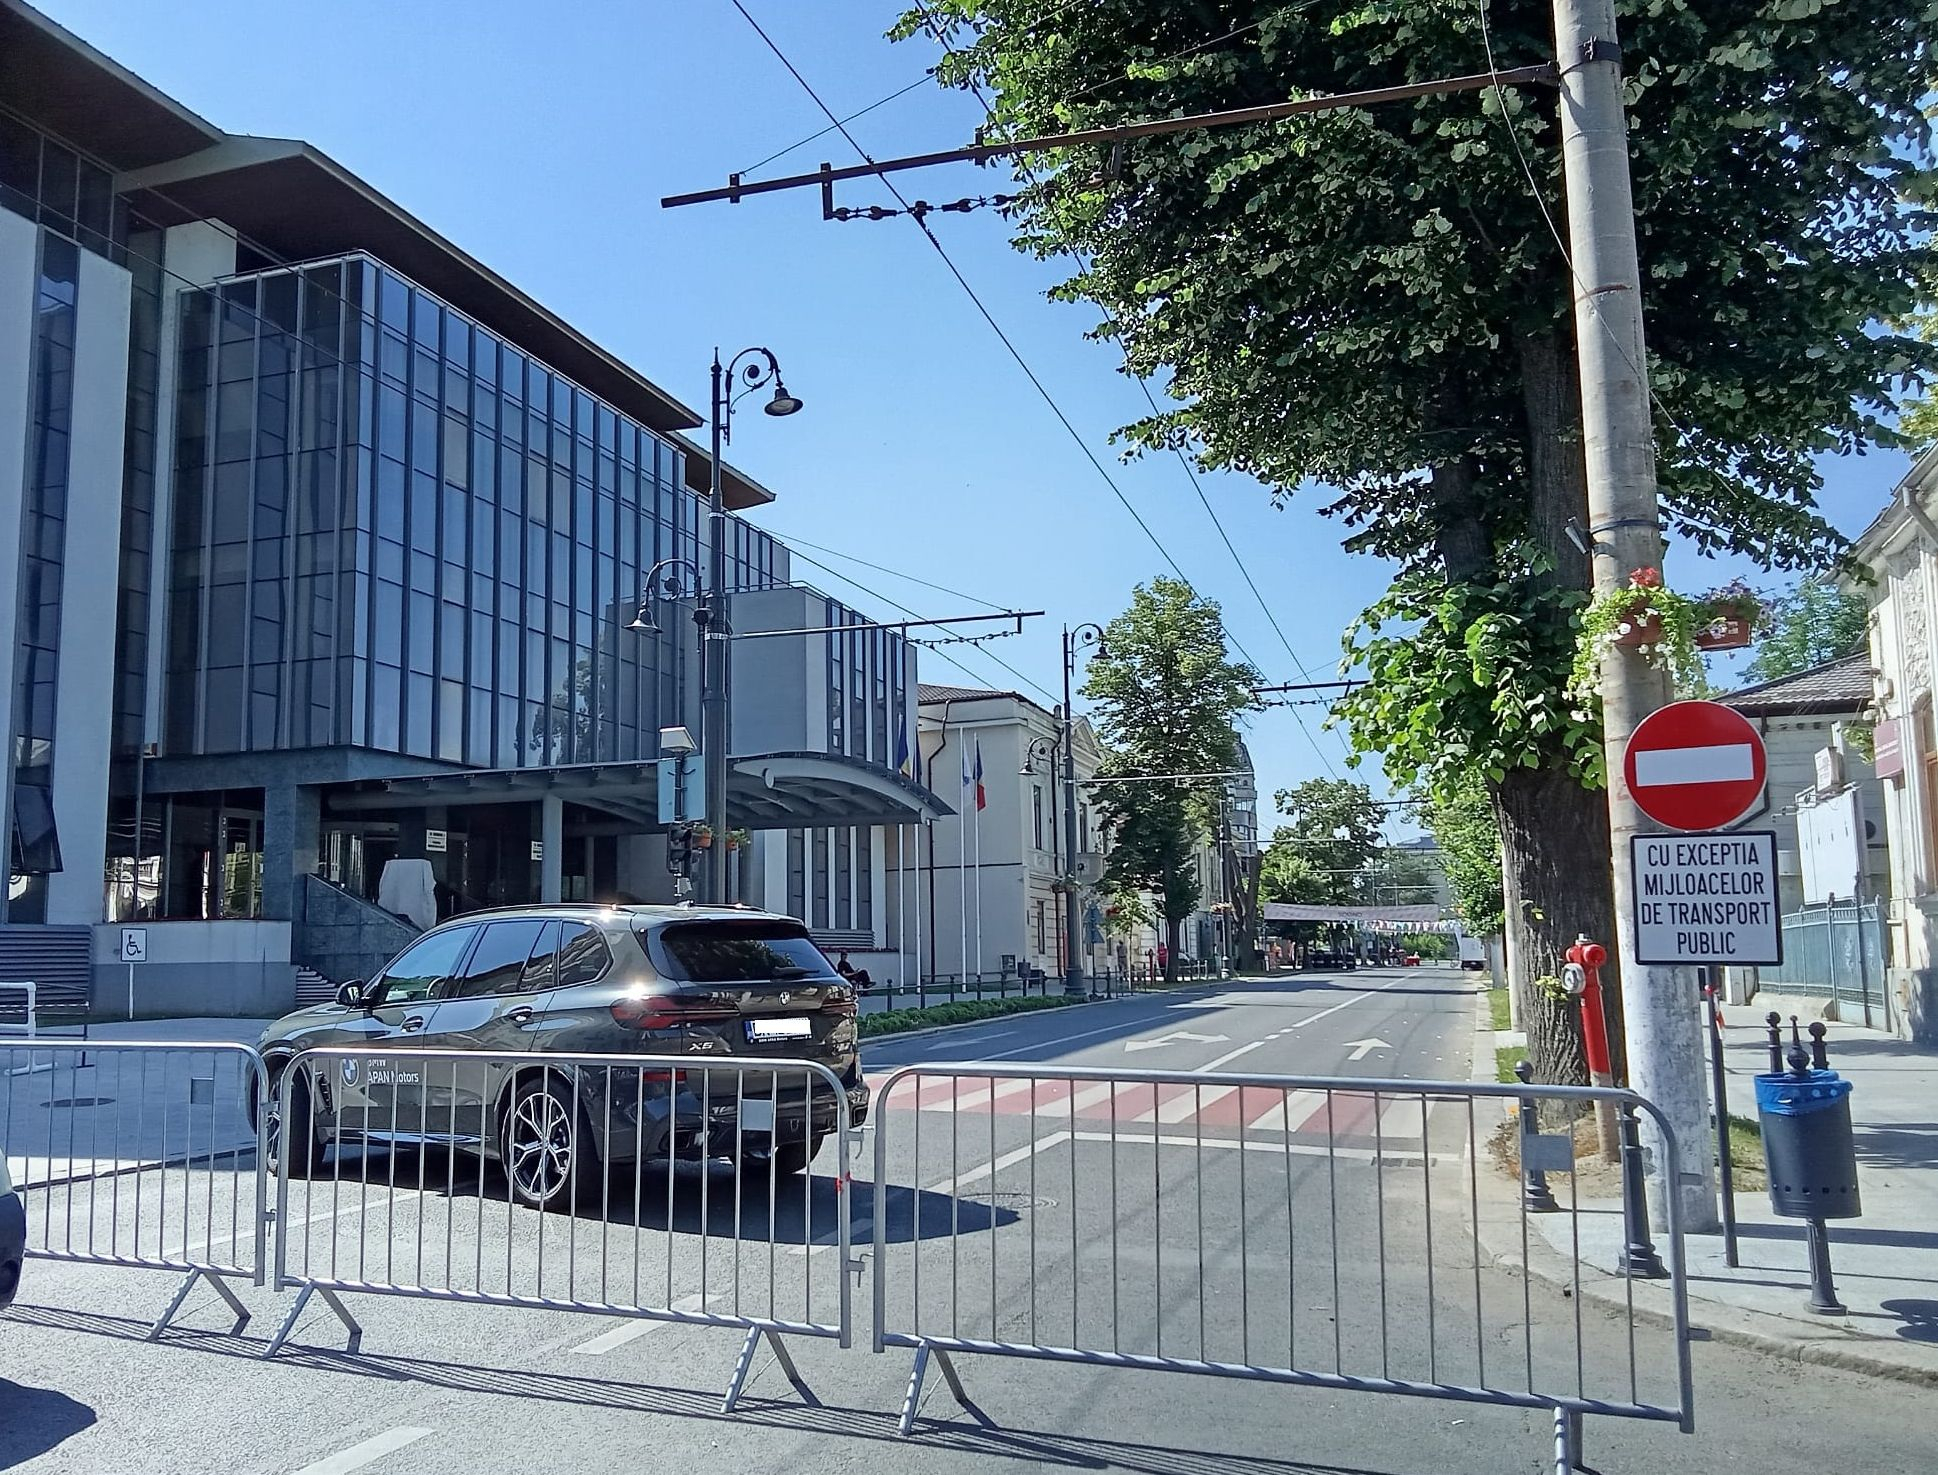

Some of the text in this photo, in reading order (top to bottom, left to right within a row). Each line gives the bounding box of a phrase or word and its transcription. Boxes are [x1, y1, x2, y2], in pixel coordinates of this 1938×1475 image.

[1648, 842, 1760, 867] CU EXCEPTIA
[1644, 872, 1765, 896] MIJLOACELOR
[1641, 901, 1771, 926] DE TRANSPORT
[1677, 931, 1736, 955] PUBLIC
